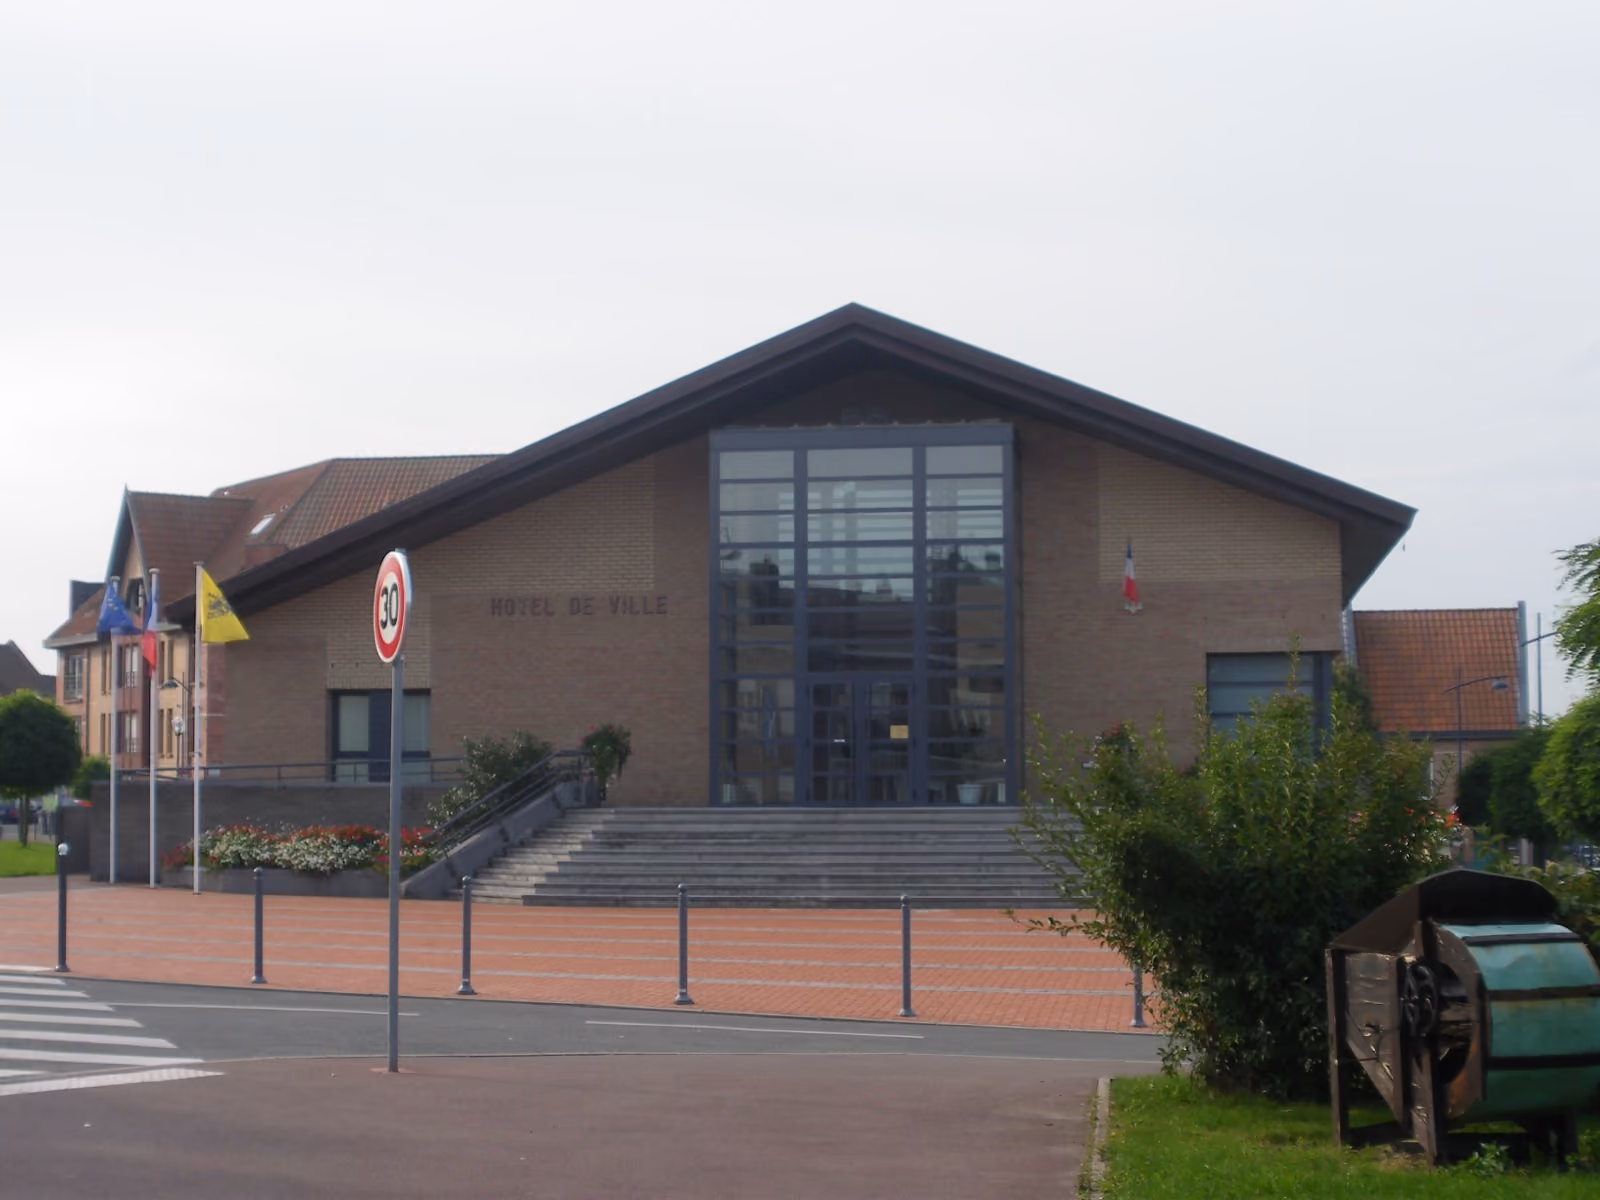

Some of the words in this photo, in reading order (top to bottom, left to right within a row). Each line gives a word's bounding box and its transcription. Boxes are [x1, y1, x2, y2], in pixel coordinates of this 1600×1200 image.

[380, 582, 399, 630] 30
[569, 596, 595, 616] DE
[609, 595, 668, 616] VILLE
